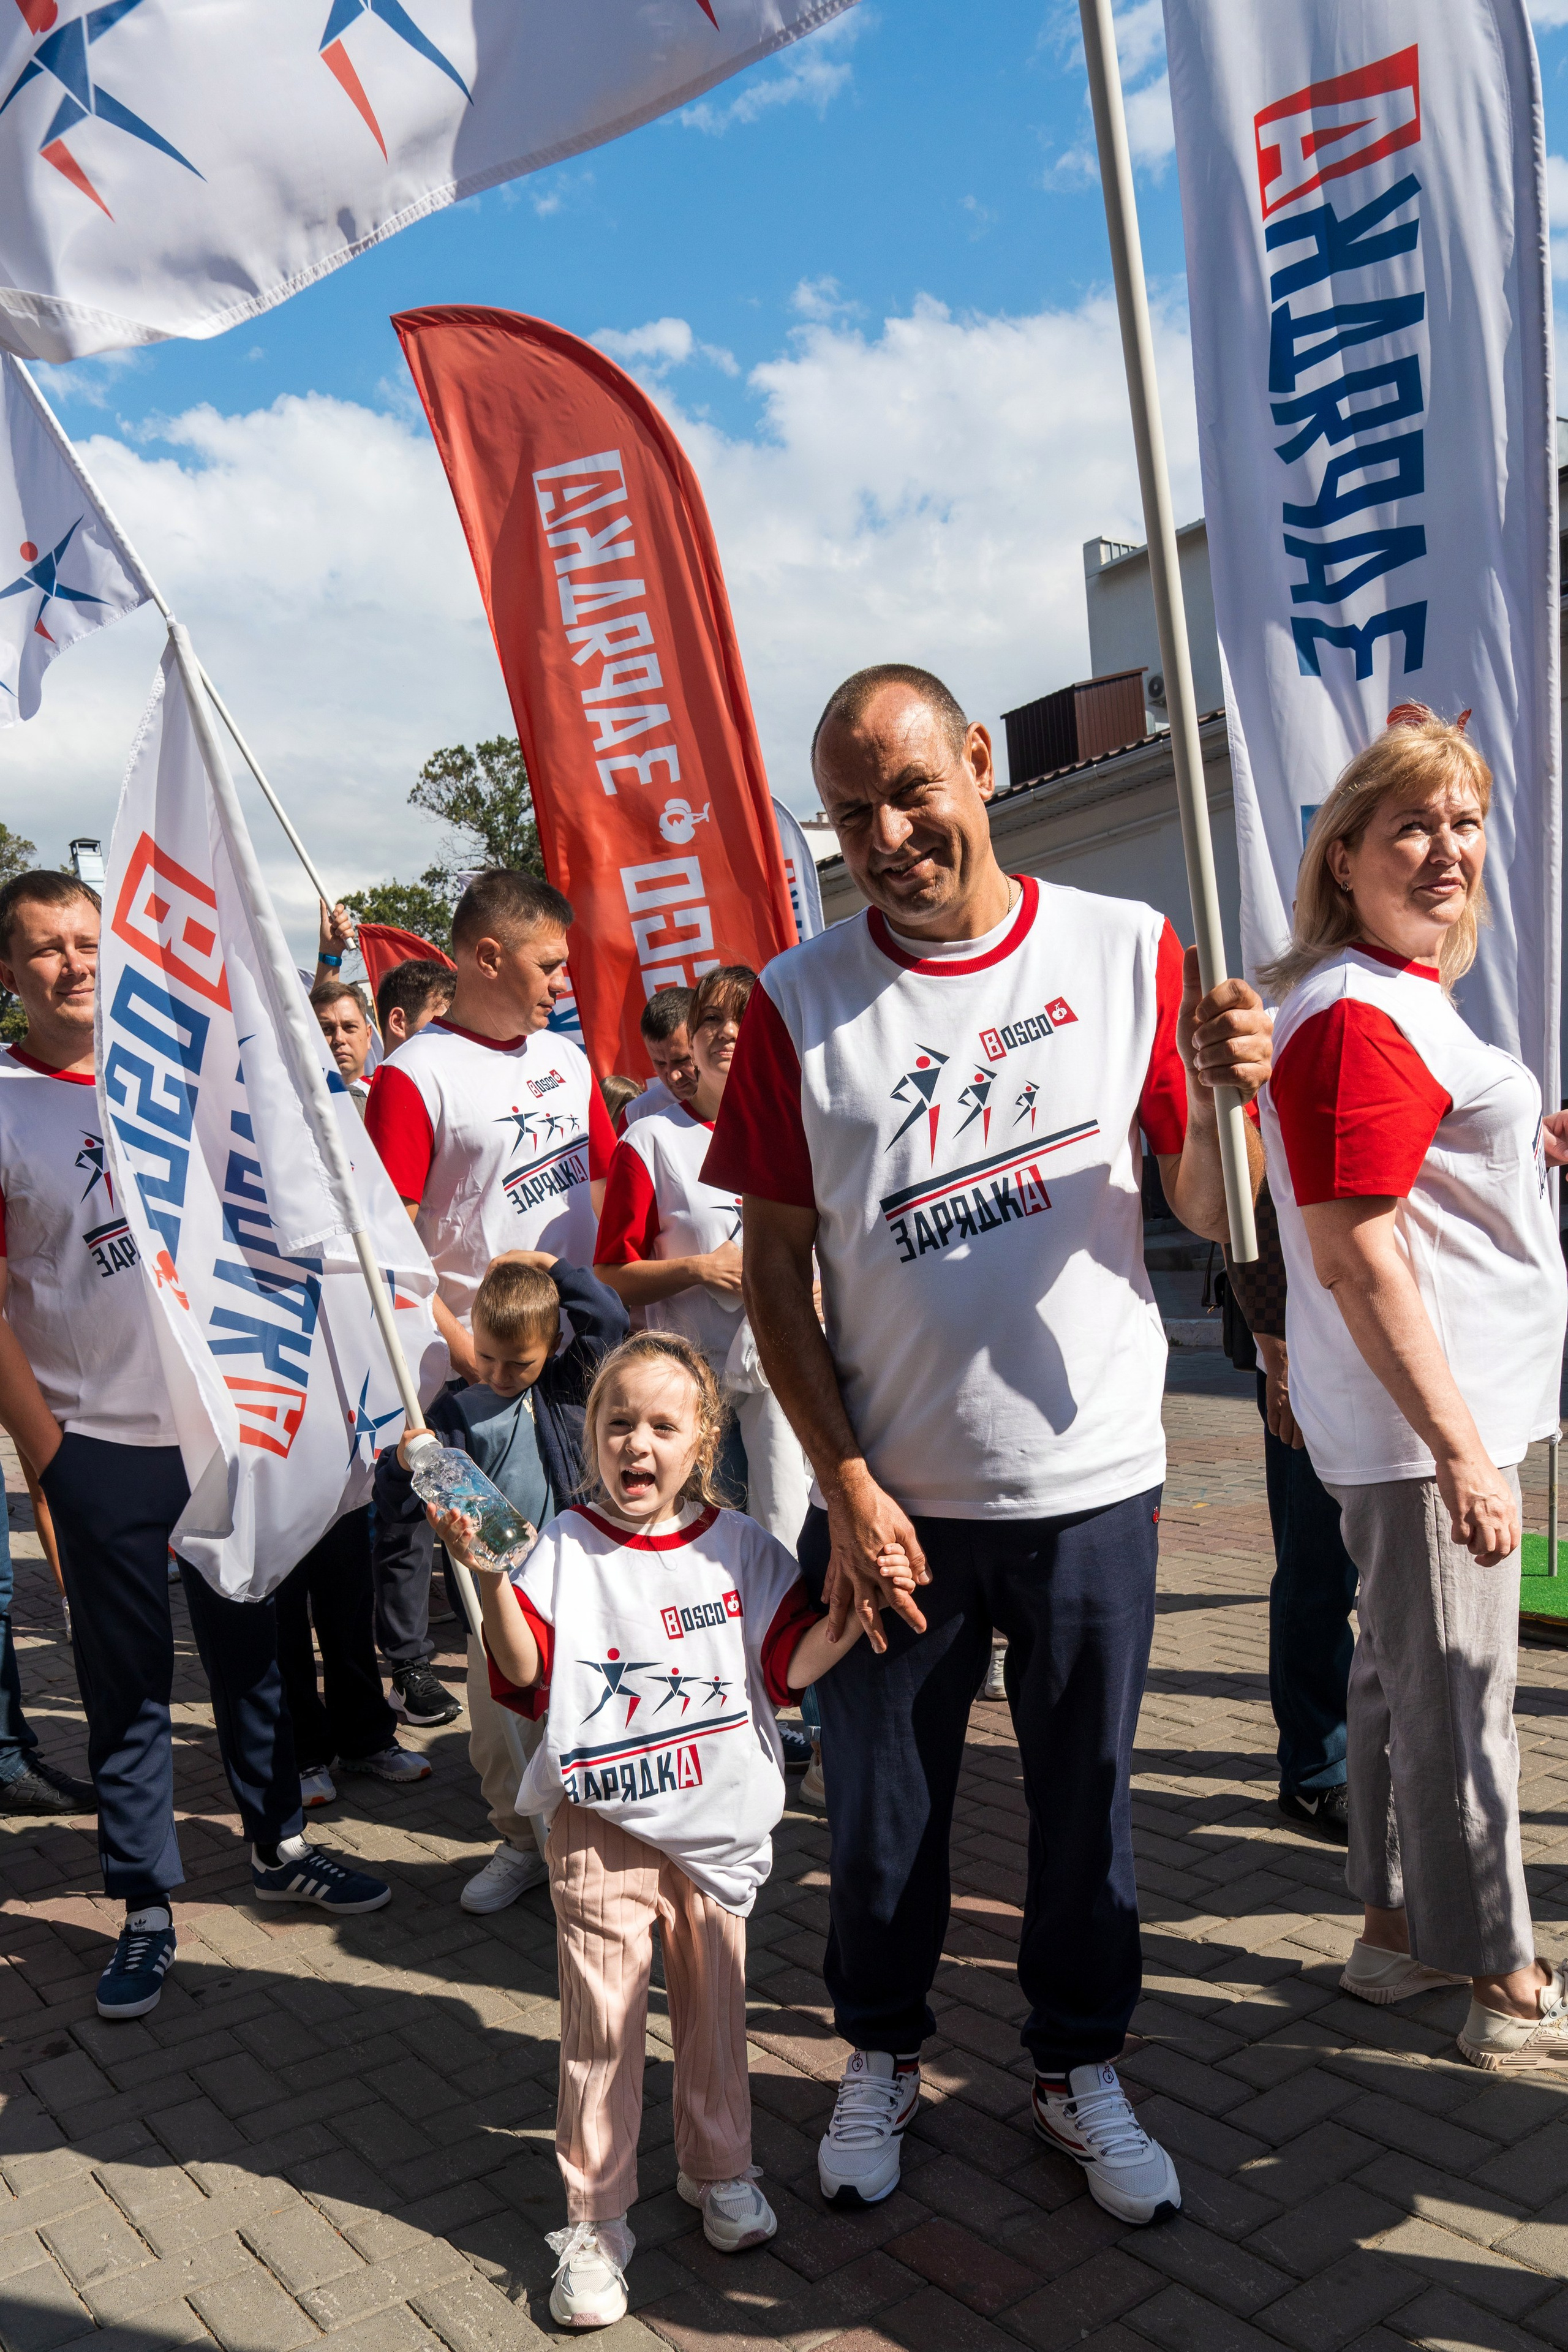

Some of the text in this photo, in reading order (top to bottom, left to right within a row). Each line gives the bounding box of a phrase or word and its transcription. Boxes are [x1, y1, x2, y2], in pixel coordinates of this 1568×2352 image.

[979, 1014, 1052, 1061] BOSCO
[527, 1076, 559, 1098] BOSCO
[507, 1155, 589, 1214] ЗАРЯДКА
[890, 1164, 1052, 1263] ЗАРЯДКА
[661, 1602, 724, 1639] BOSCO
[564, 1743, 703, 1803] ЗАРЯДКА
